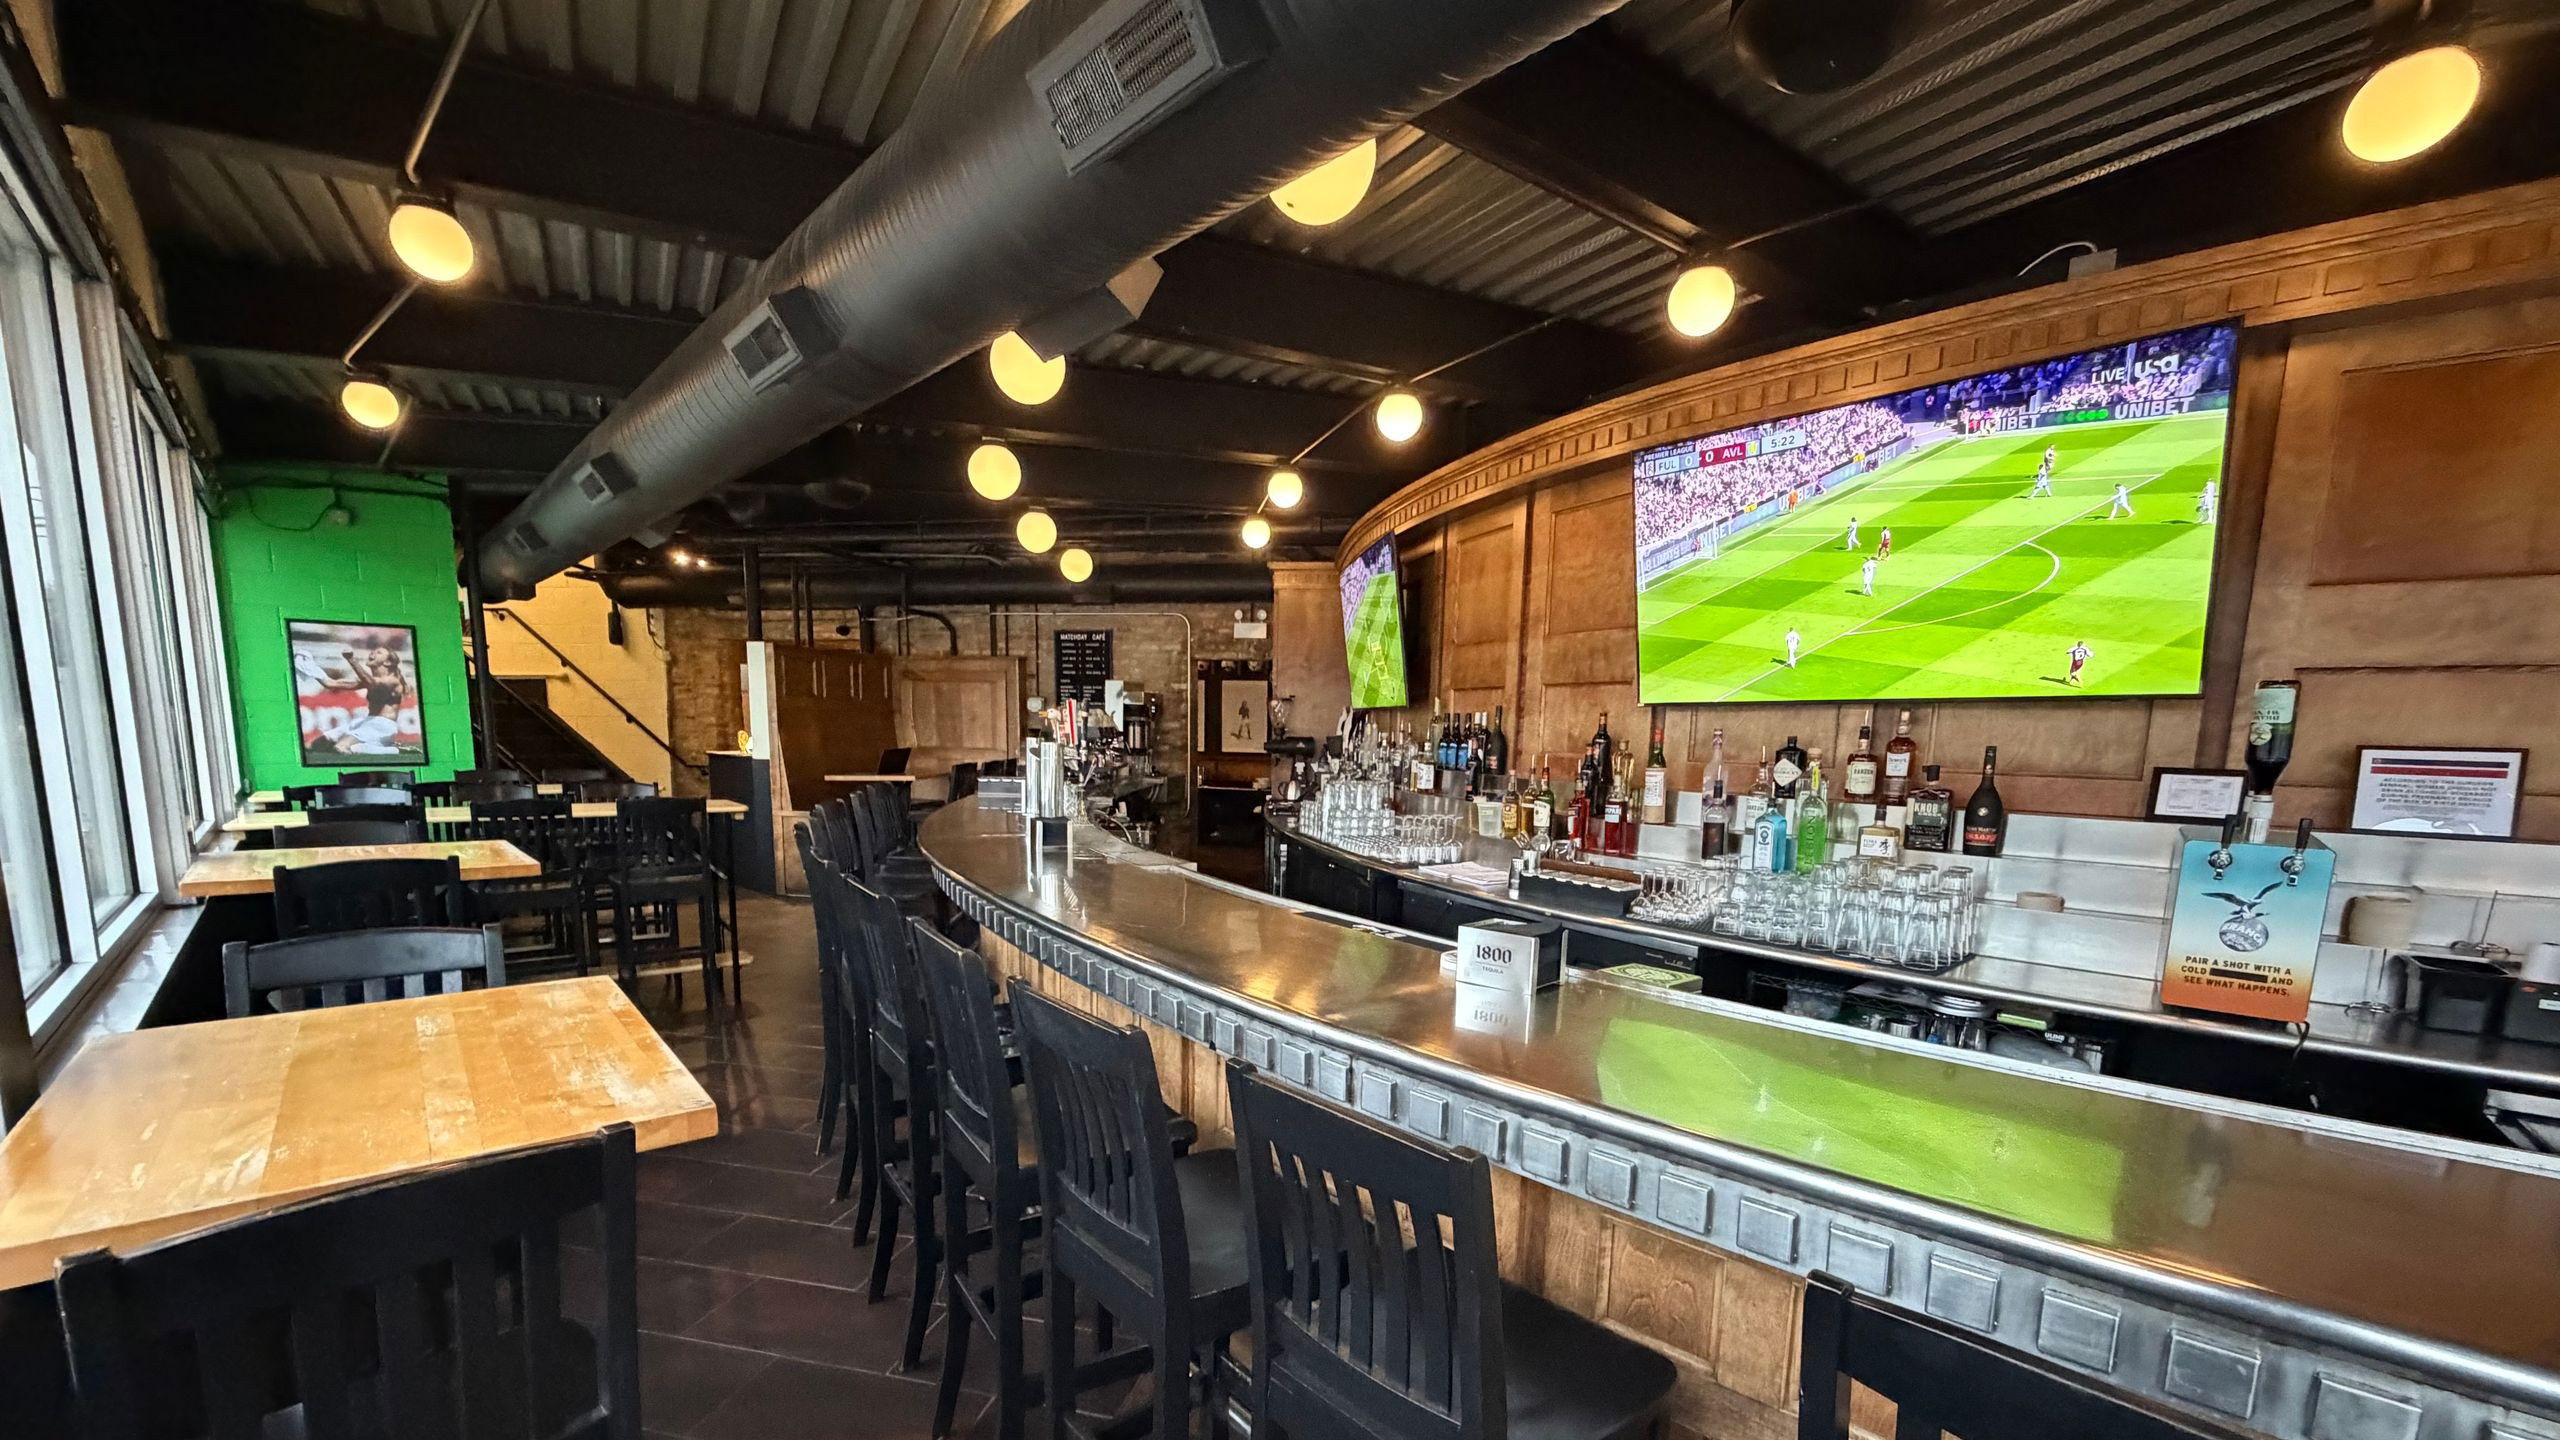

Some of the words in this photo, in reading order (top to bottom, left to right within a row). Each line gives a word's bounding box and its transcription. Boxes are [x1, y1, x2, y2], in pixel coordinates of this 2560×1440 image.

[2092, 367, 2126, 385] LIVE
[2115, 396, 2195, 420] UNIBET
[1770, 435, 1796, 449] 5:22
[1643, 450, 1669, 462] PREMIER
[1669, 444, 1696, 456] LEAGUE
[1658, 459, 1677, 471] FUL
[1684, 456, 1693, 466] 0
[1705, 450, 1715, 463] 0
[1722, 446, 1745, 459] AVL
[1060, 633, 1088, 641] MATCHDAY
[1914, 802, 1939, 813] KNOB
[1476, 944, 1512, 964] 1800
[1482, 965, 1504, 975] TEQUILA
[2185, 955, 2209, 966] PAIR
[2212, 958, 2219, 966] A
[2223, 960, 2250, 971] SHOT
[2254, 963, 2281, 975] WITH
[2284, 967, 2292, 975] A
[2181, 965, 2207, 975] COLD
[2270, 977, 2294, 986] AND
[2184, 975, 2202, 985] SEE
[2206, 977, 2235, 990] WHAT
[2237, 982, 2291, 997] HAPPENS.
